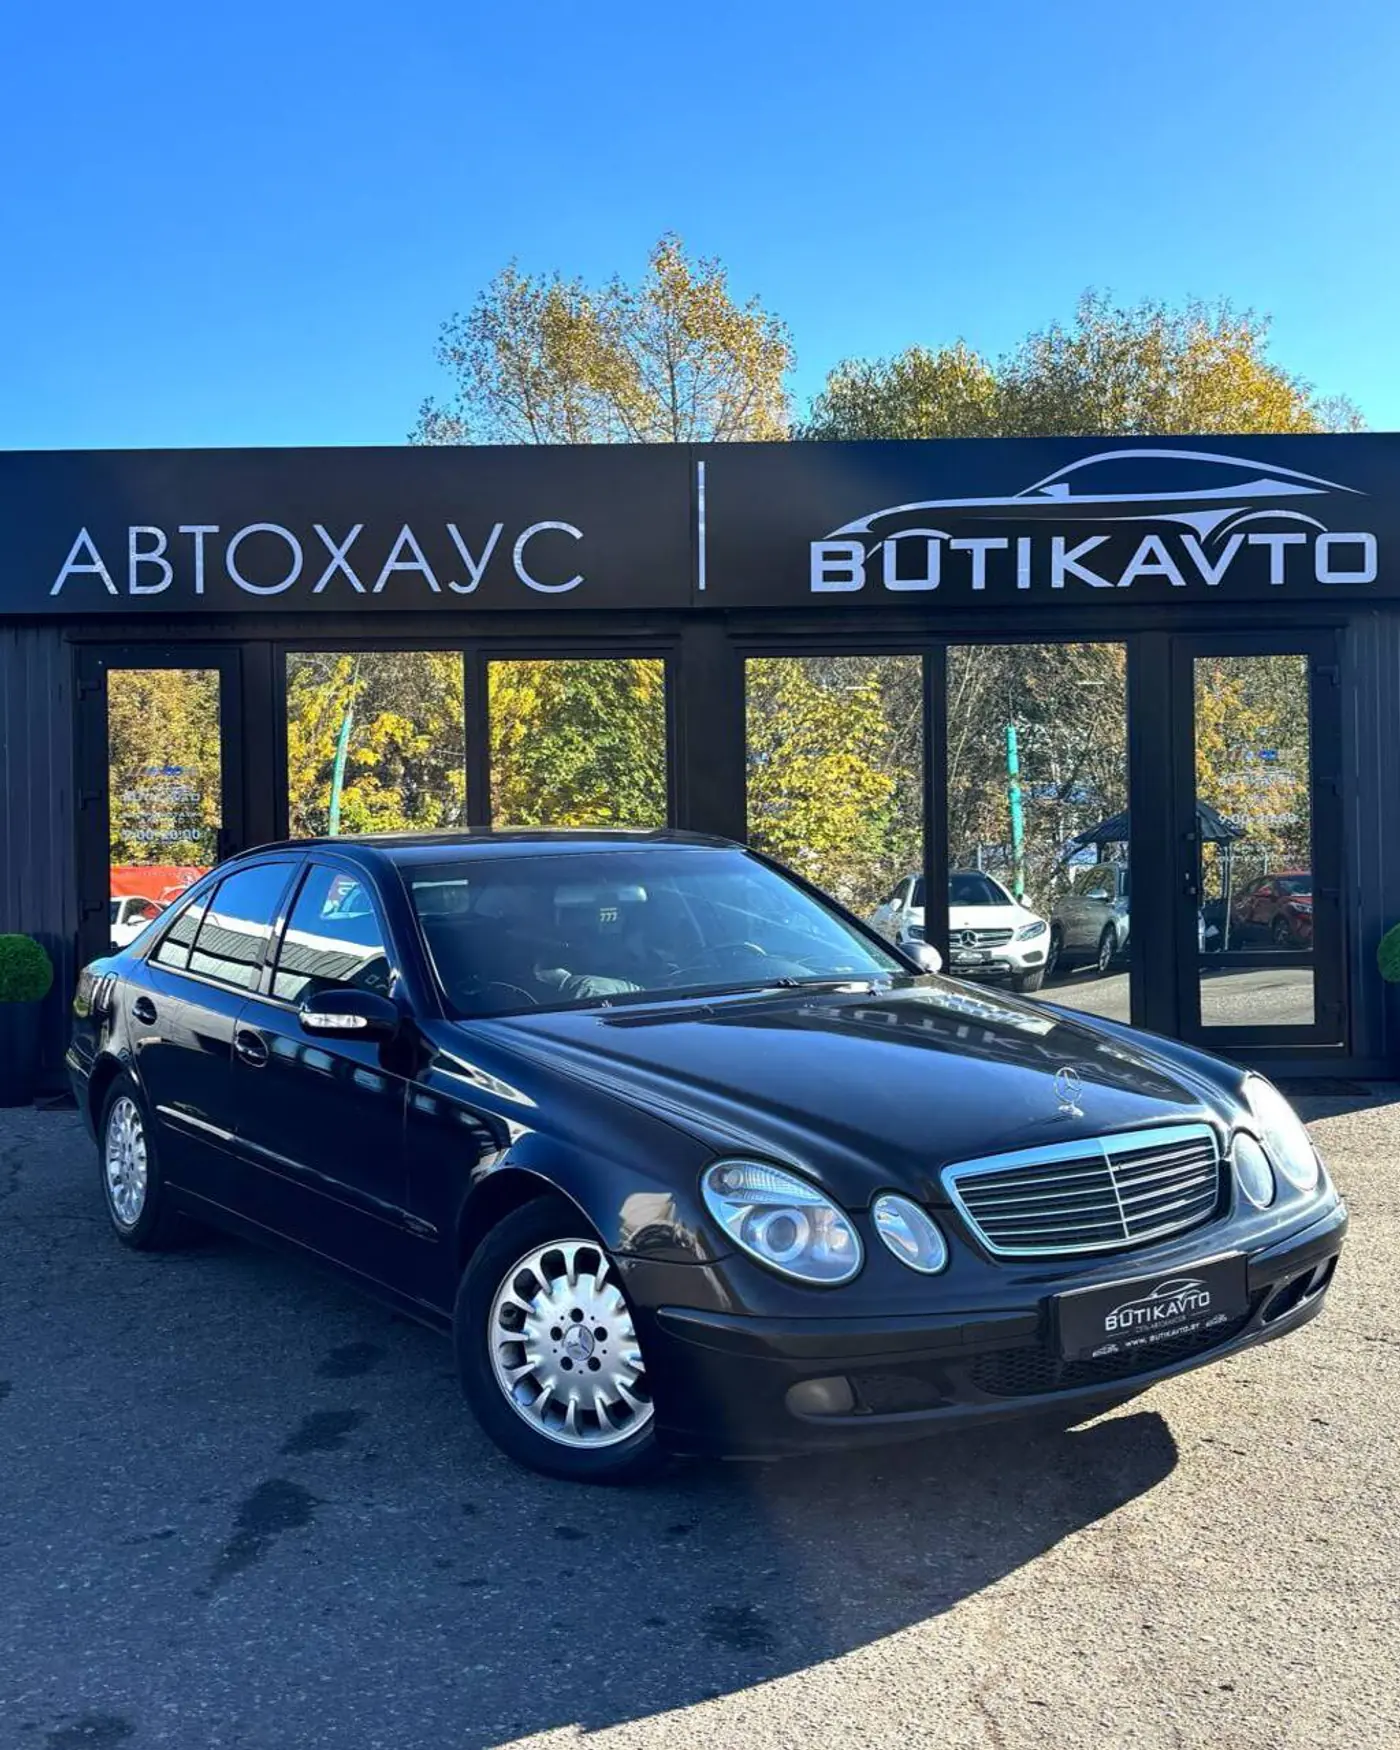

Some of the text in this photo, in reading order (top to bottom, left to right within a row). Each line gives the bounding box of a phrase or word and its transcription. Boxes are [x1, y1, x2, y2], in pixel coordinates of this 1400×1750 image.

[50, 521, 585, 596] АВТОХАУС
[810, 531, 1378, 593] BUTIKAVTO
[1105, 1291, 1211, 1332] BUTIKAVTO
